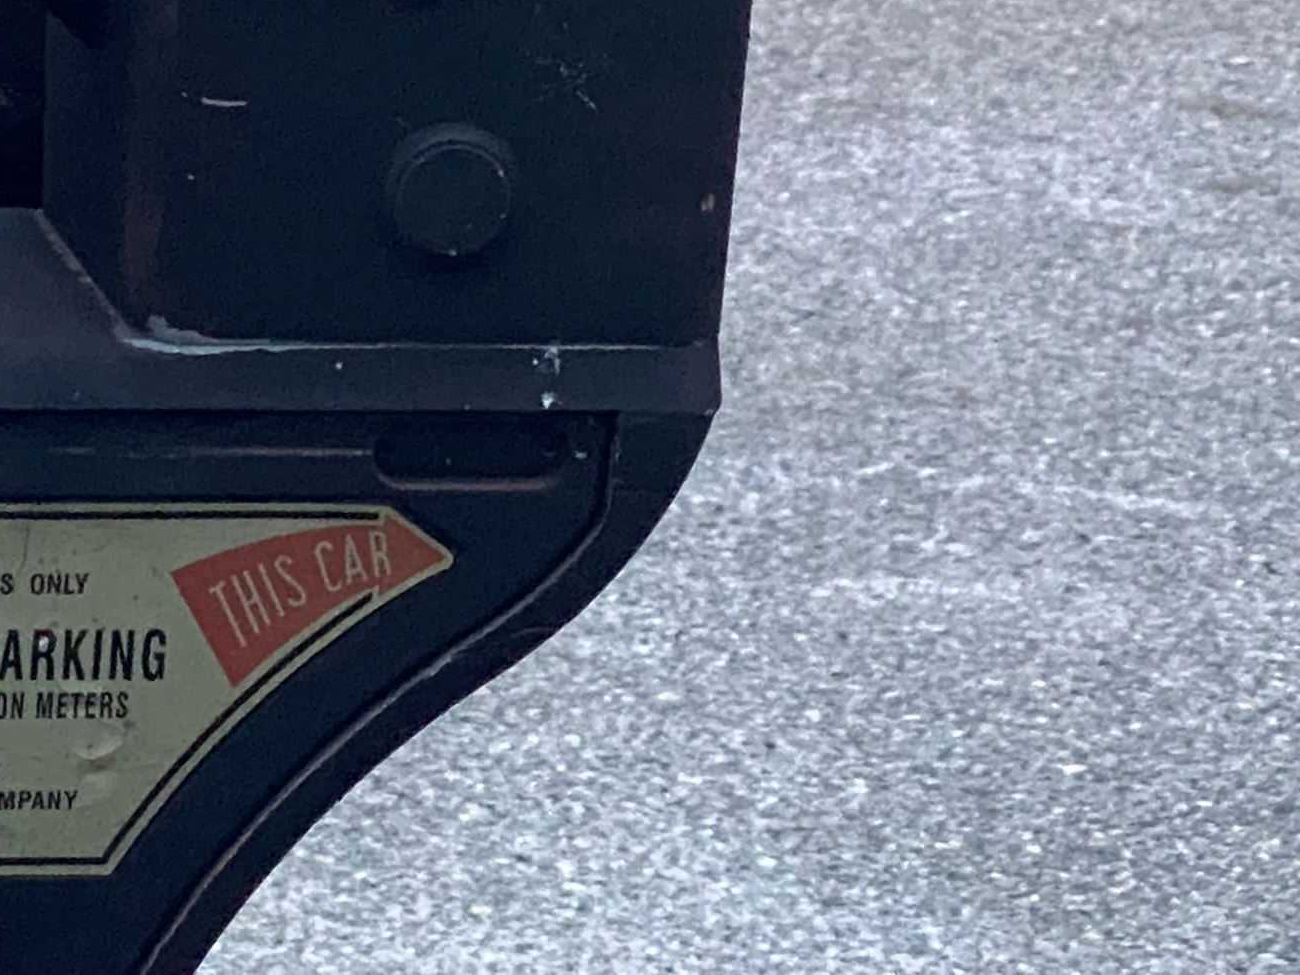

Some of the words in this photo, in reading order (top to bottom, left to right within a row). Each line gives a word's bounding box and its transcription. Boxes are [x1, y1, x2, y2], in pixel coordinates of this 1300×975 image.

[30, 573, 90, 594] ONLY
[208, 554, 307, 648] THIS
[314, 529, 391, 593] CAR
[35, 692, 129, 719] METERS
